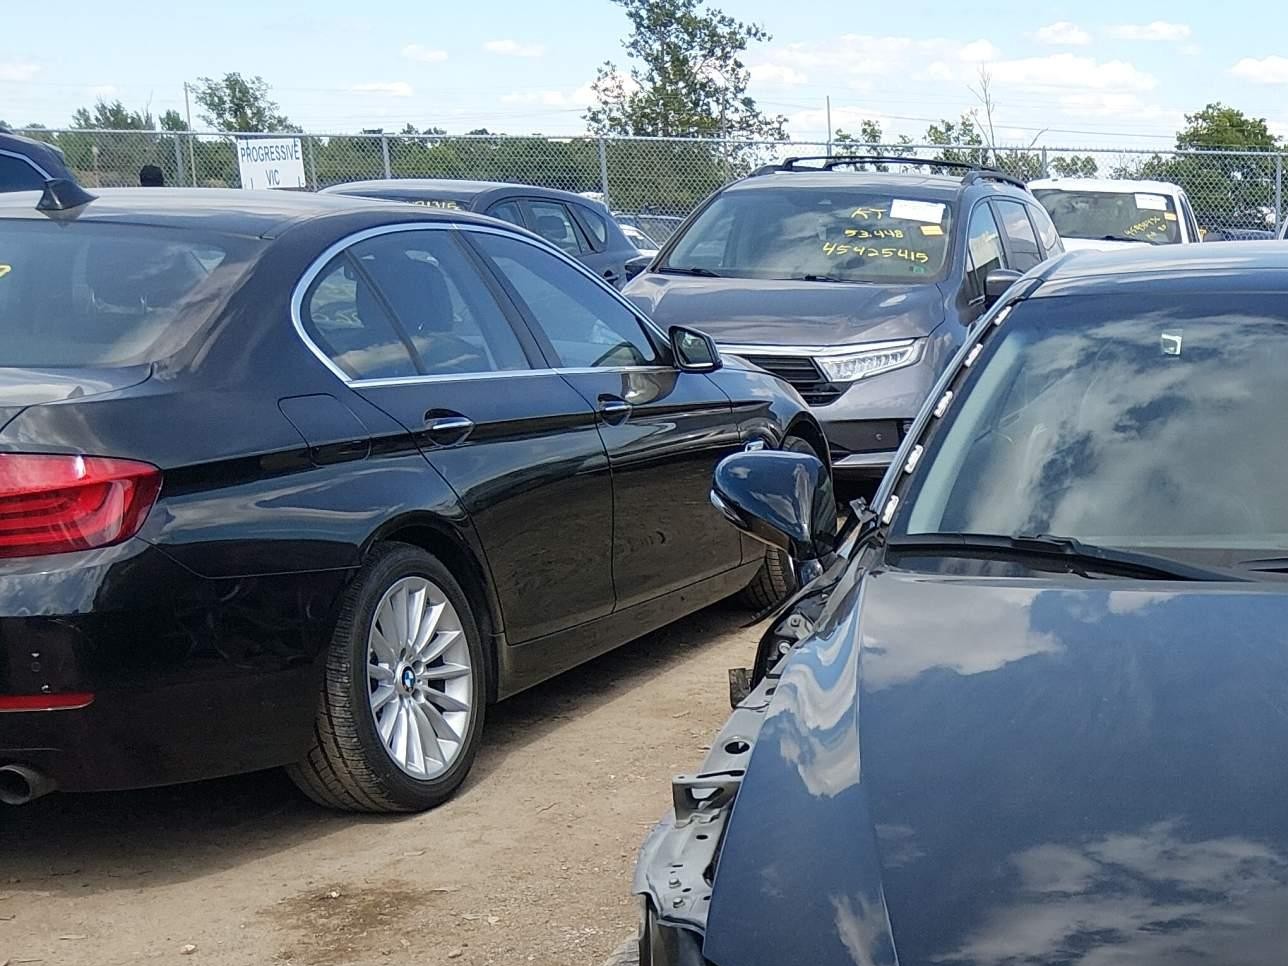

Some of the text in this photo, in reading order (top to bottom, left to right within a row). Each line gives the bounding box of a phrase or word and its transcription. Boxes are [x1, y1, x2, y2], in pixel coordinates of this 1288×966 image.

[240, 143, 300, 163] PROGRESSIVE
[265, 169, 281, 187] VIC
[823, 242, 929, 264] 45425415
